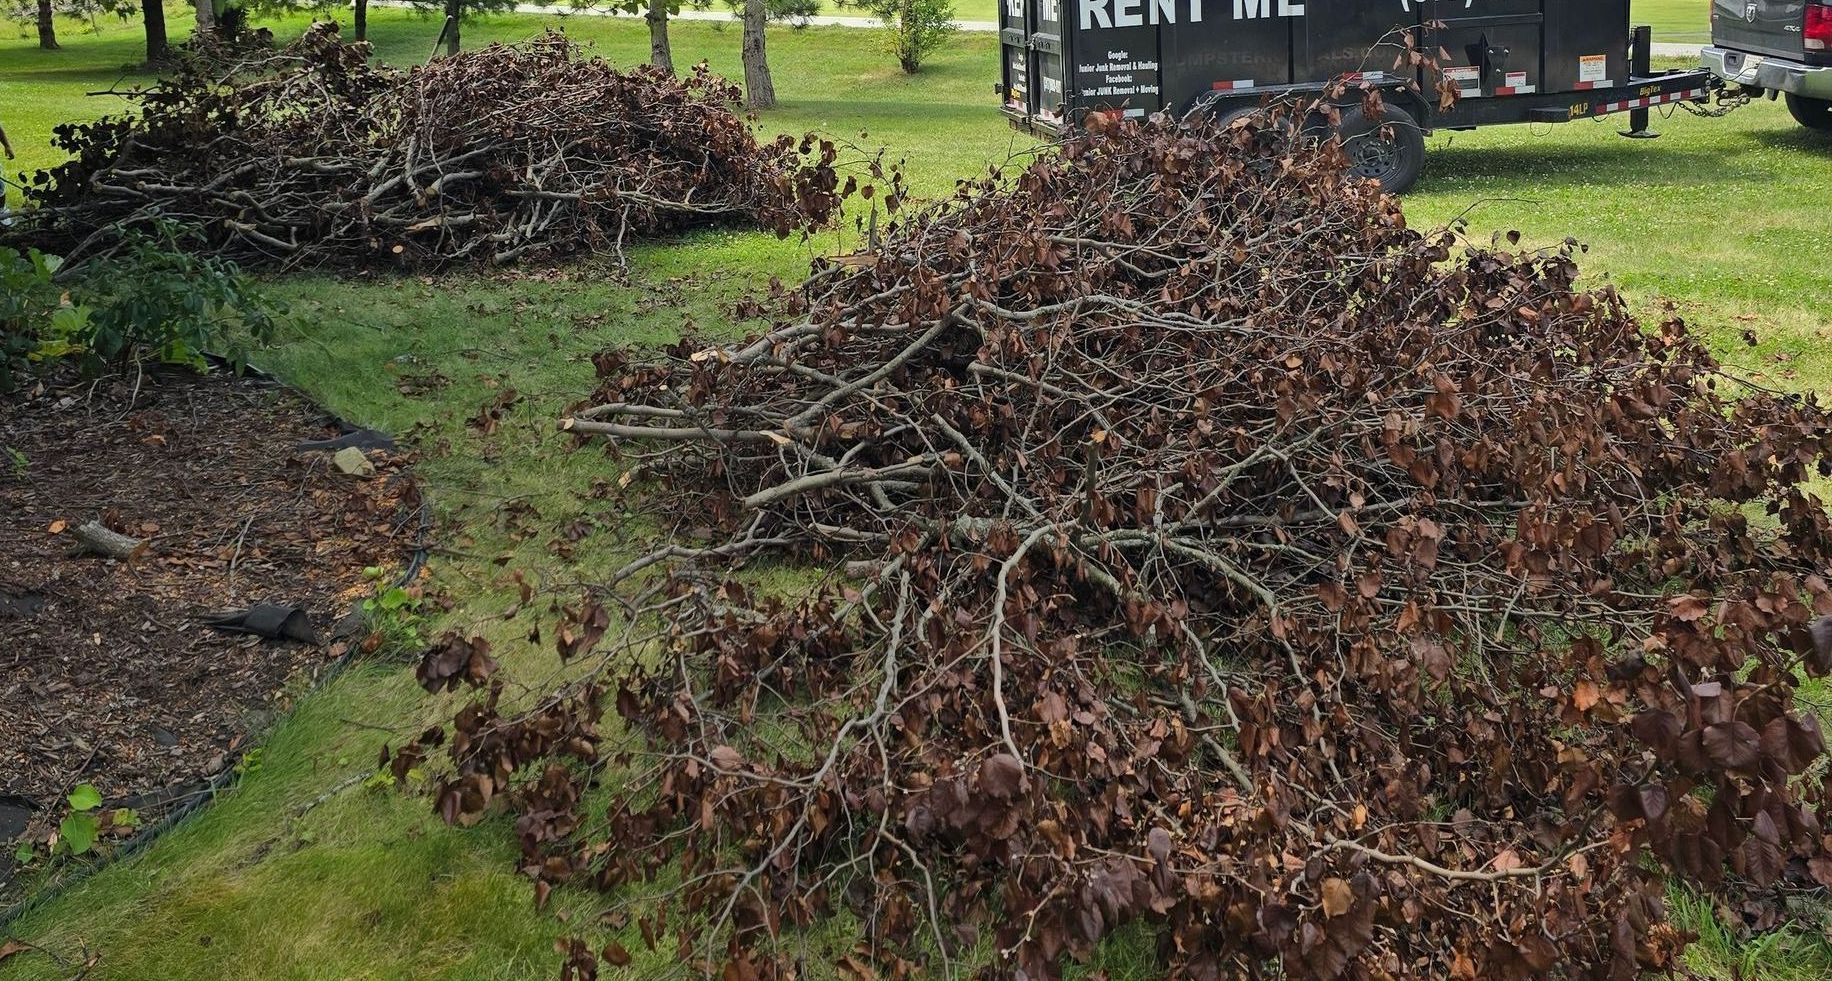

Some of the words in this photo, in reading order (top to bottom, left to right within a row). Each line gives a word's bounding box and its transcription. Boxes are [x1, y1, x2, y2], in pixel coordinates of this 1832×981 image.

[1107, 50, 1129, 61] Google:
[1095, 63, 1109, 72] Junk
[1109, 62, 1132, 71] Removal
[1132, 61, 1137, 70] &
[1137, 61, 1158, 72] Hauling
[1105, 74, 1133, 83] Facebook:
[1082, 87, 1096, 96] unior
[1097, 86, 1112, 95] JUNK
[1113, 86, 1135, 95] Removal
[1140, 84, 1159, 95] Moving
[1639, 85, 1661, 97] BigTex
